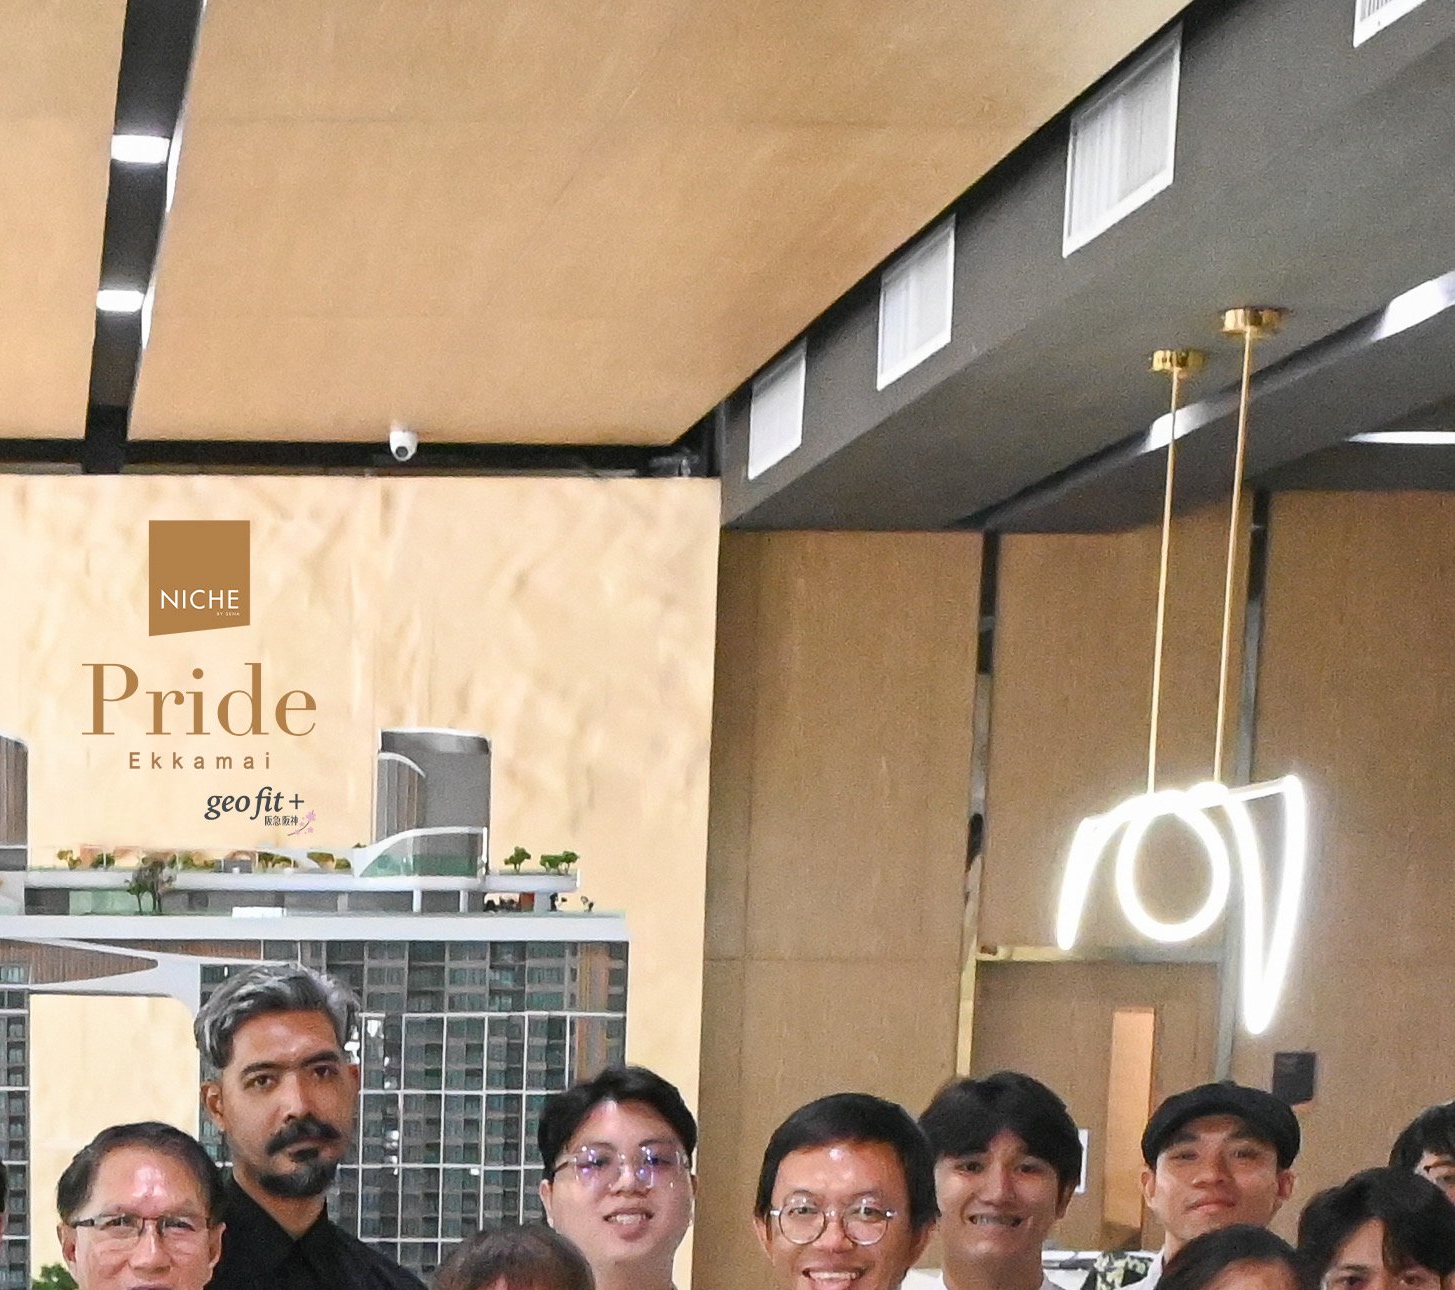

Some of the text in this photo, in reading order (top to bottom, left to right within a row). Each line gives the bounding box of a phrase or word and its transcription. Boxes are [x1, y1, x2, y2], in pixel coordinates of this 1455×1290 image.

[160, 589, 239, 610] NICHE
[81, 662, 317, 737] Pride
[129, 752, 270, 770] Ekkamai
[204, 795, 251, 821] geo
[264, 815, 299, 826] 阪急阪神
